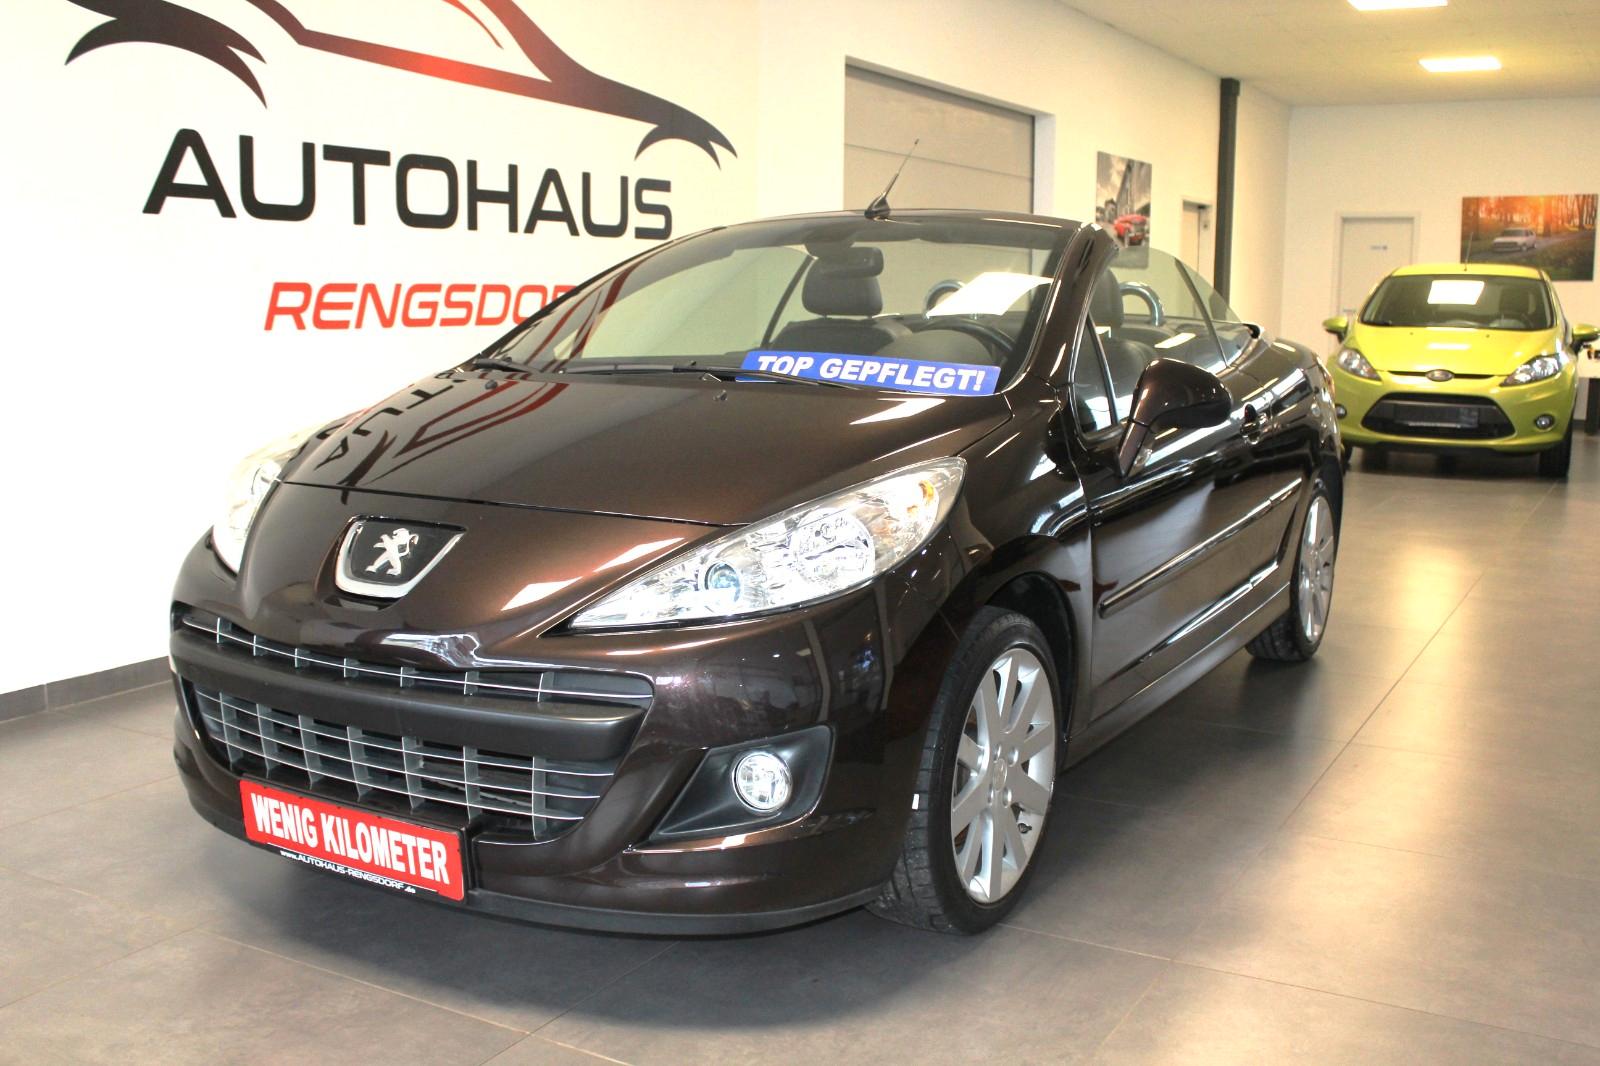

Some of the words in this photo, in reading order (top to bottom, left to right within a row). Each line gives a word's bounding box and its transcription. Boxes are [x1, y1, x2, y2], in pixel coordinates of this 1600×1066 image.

[142, 128, 673, 240] AUTOHAUS
[757, 355, 814, 376] TOP
[819, 358, 986, 390] GEPFLEGT!
[251, 793, 318, 848] WENIG
[321, 813, 449, 885] KILOMETER
